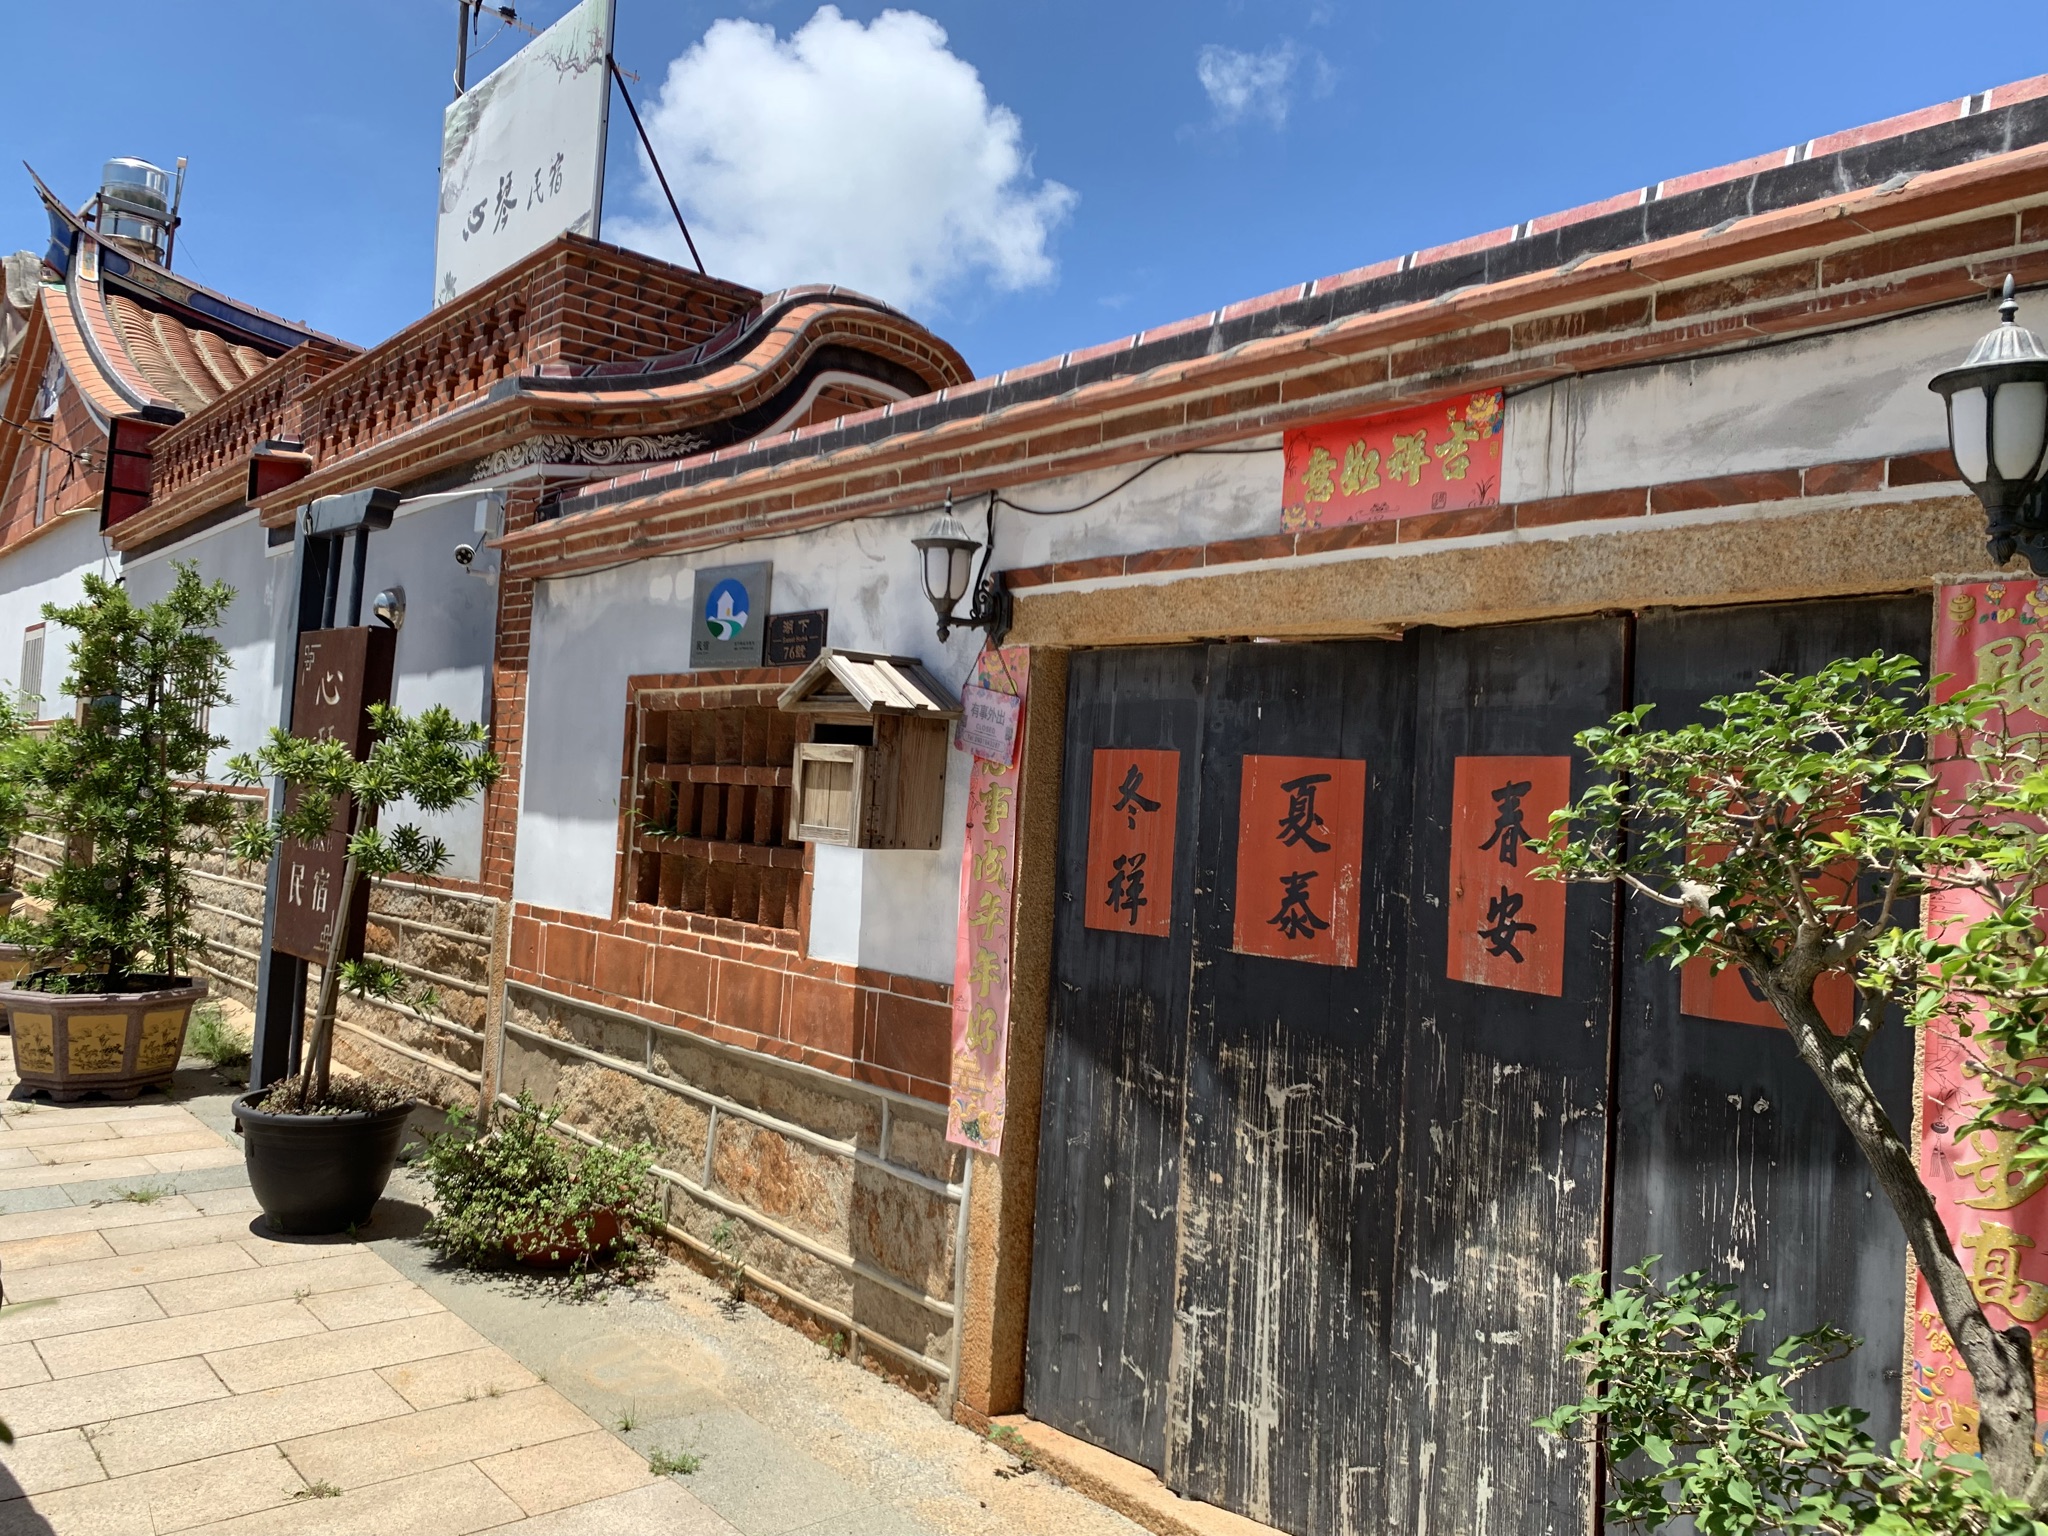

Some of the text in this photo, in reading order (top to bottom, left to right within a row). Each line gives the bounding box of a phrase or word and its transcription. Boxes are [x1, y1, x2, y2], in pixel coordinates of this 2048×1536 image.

[462, 152, 565, 242] 心琴民宿
[1302, 420, 1480, 504] 吉祥如意
[971, 702, 1006, 726] 有事外出
[975, 723, 996, 734] CLOSED
[289, 861, 330, 913] 民宿
[1104, 763, 1162, 925] 冬祥
[1267, 774, 1331, 941] 夏泰
[1477, 780, 1537, 964] 春安
